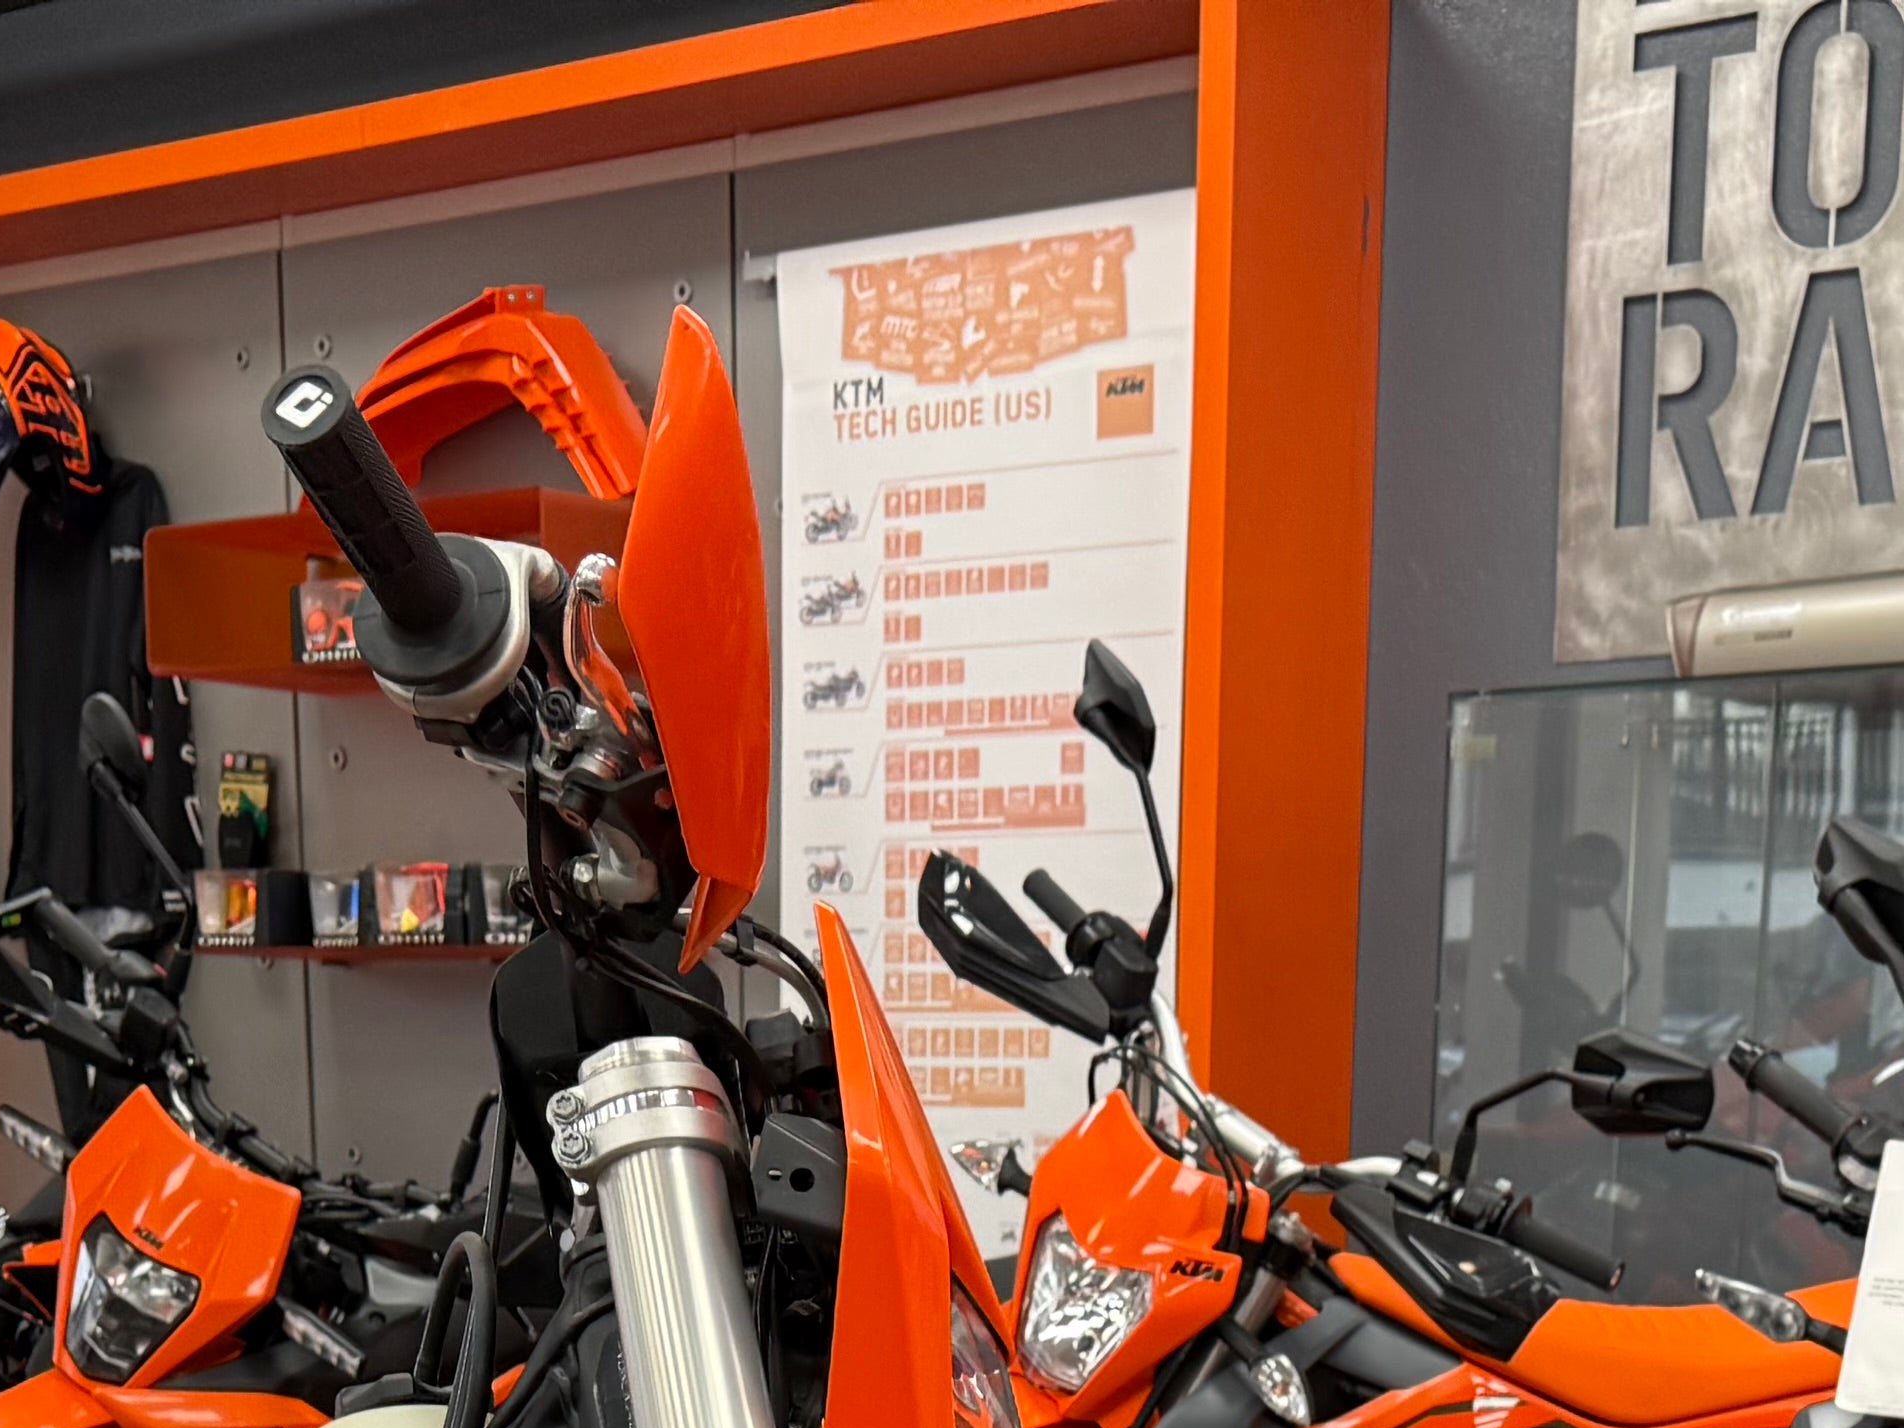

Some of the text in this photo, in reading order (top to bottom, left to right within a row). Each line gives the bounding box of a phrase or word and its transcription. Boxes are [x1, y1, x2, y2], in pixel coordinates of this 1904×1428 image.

[833, 376, 885, 411] KTM
[833, 387, 1052, 443] TECH GUIDE (US)
[1170, 1257, 1224, 1282] KTM
